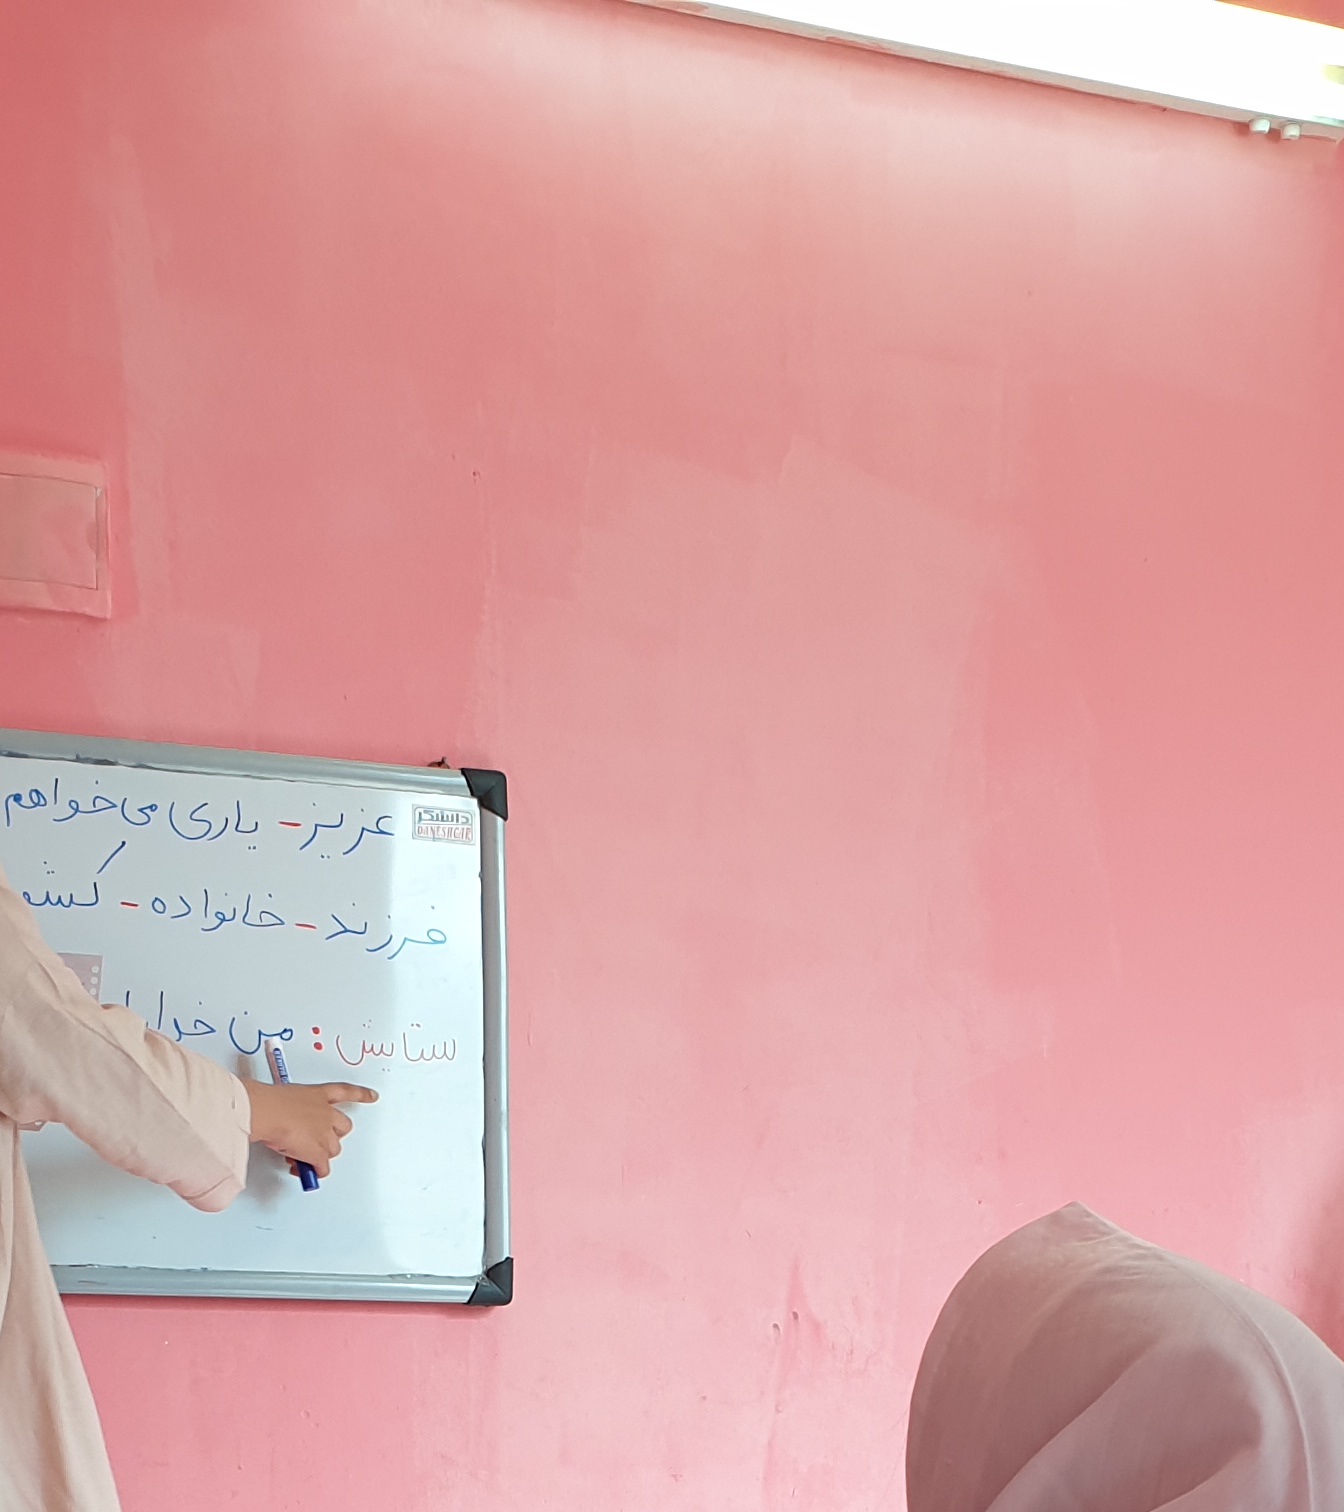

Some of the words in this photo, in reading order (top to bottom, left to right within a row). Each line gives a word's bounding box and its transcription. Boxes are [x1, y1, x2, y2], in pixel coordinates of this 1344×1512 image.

[168, 800, 259, 850] یاری
[299, 802, 395, 860] عزیز
[150, 888, 286, 932] خانواده
[324, 902, 447, 960] فرزند
[157, 990, 218, 1042] خدا
[229, 1010, 294, 1056] من
